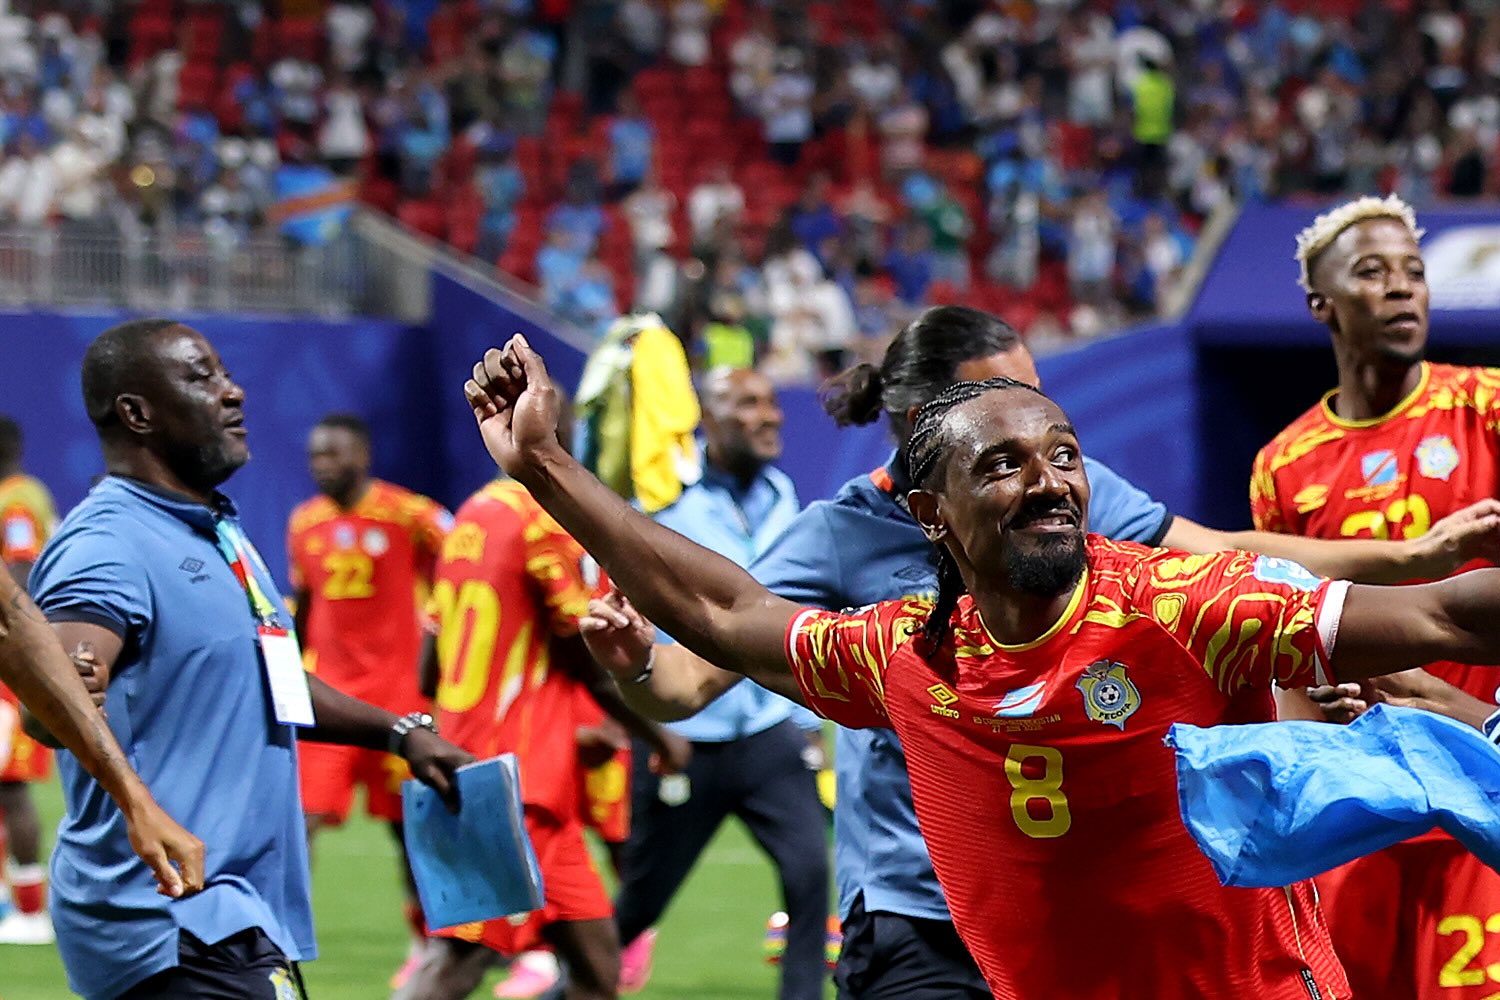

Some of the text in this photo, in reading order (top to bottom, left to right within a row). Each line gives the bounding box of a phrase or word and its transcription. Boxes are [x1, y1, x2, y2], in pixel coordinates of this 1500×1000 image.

[323, 553, 375, 600] 22
[930, 704, 960, 719] umbro
[1004, 744, 1072, 839] 8
